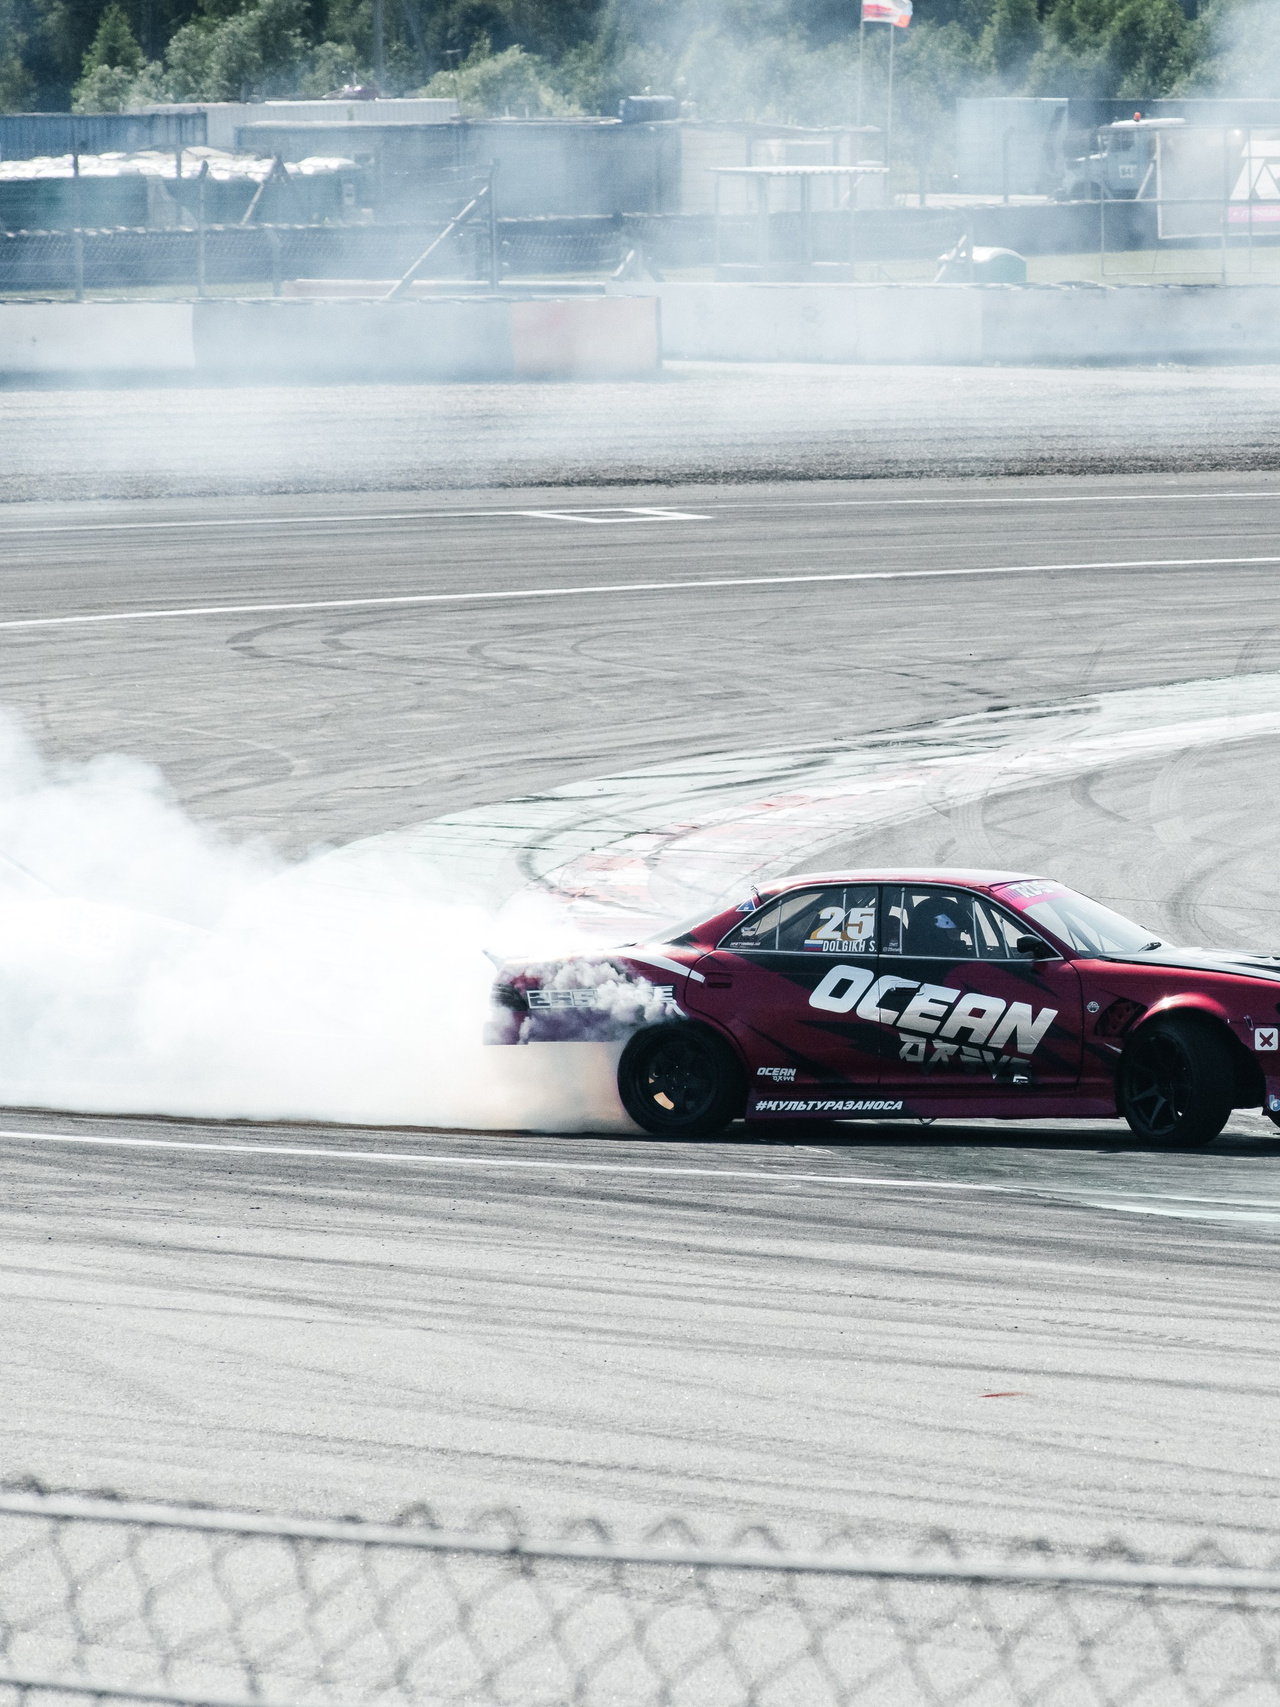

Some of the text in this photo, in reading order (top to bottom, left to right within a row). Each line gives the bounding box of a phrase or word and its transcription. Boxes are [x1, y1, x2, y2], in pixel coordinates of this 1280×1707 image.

[816, 906, 876, 941] 25
[822, 940, 866, 952] DOLGIKH
[869, 940, 877, 952] S.
[809, 964, 1058, 1054] OCEAN
[757, 1067, 796, 1076] OCEAN
[755, 1100, 903, 1111] #КУЛЬТУРАЗАНОСА
